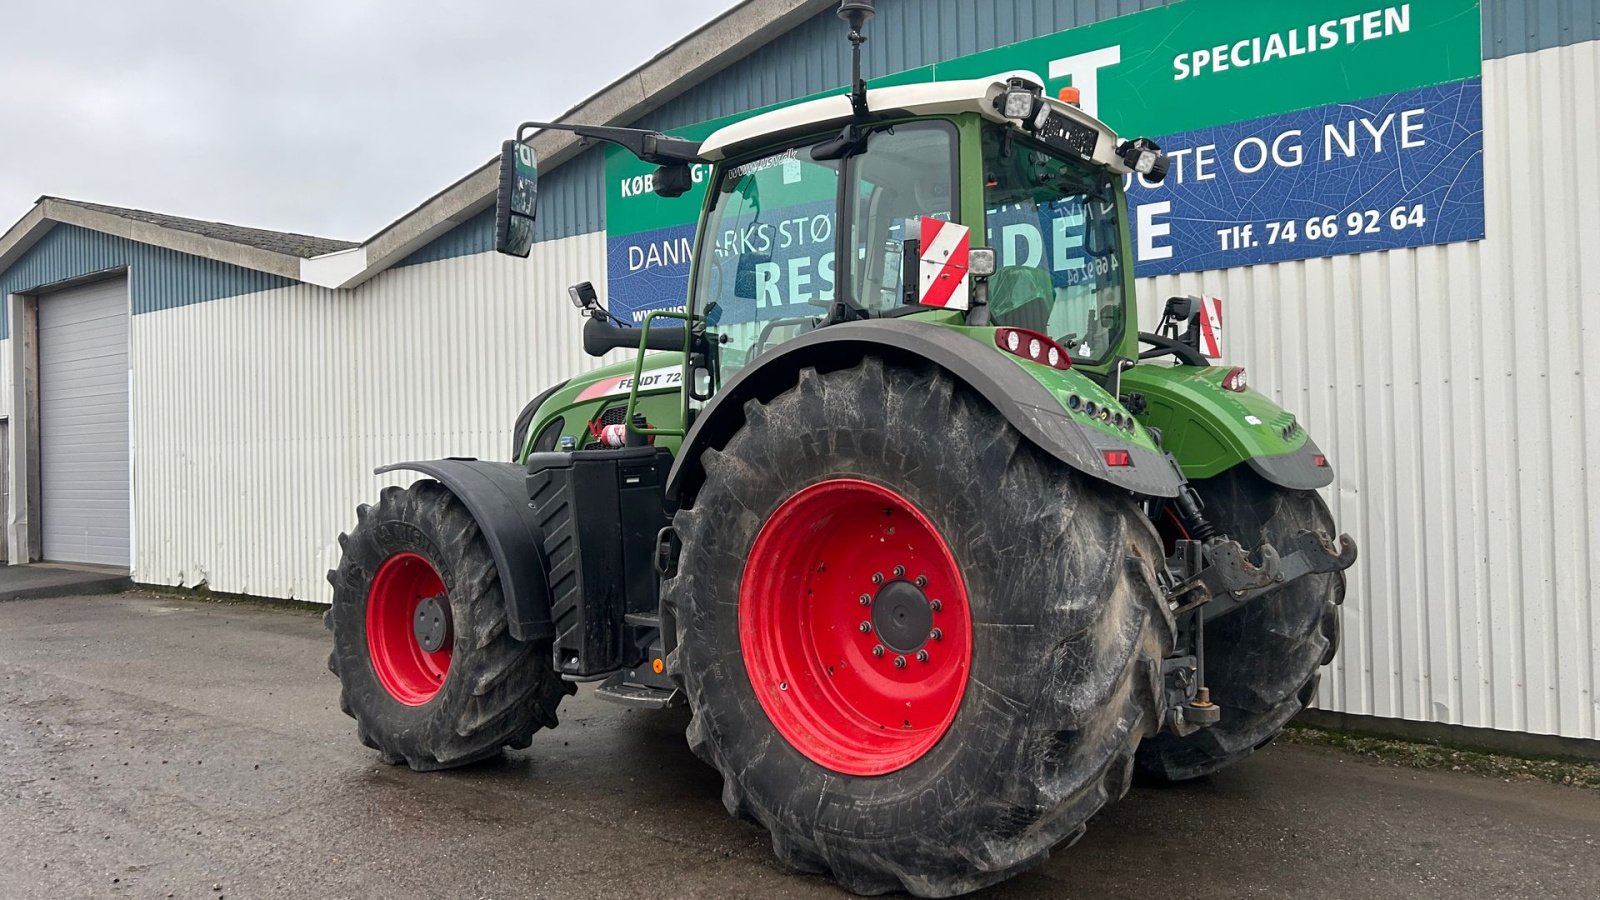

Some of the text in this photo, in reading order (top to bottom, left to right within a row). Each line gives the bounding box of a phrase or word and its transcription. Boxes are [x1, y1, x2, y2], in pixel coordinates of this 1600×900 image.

[1173, 4, 1411, 81] SPECIALISTEN
[1233, 129, 1303, 174] OG
[1324, 108, 1426, 161] NYE
[1217, 203, 1426, 251] Tlf. 74 66 92 64
[666, 372, 683, 384] 72
